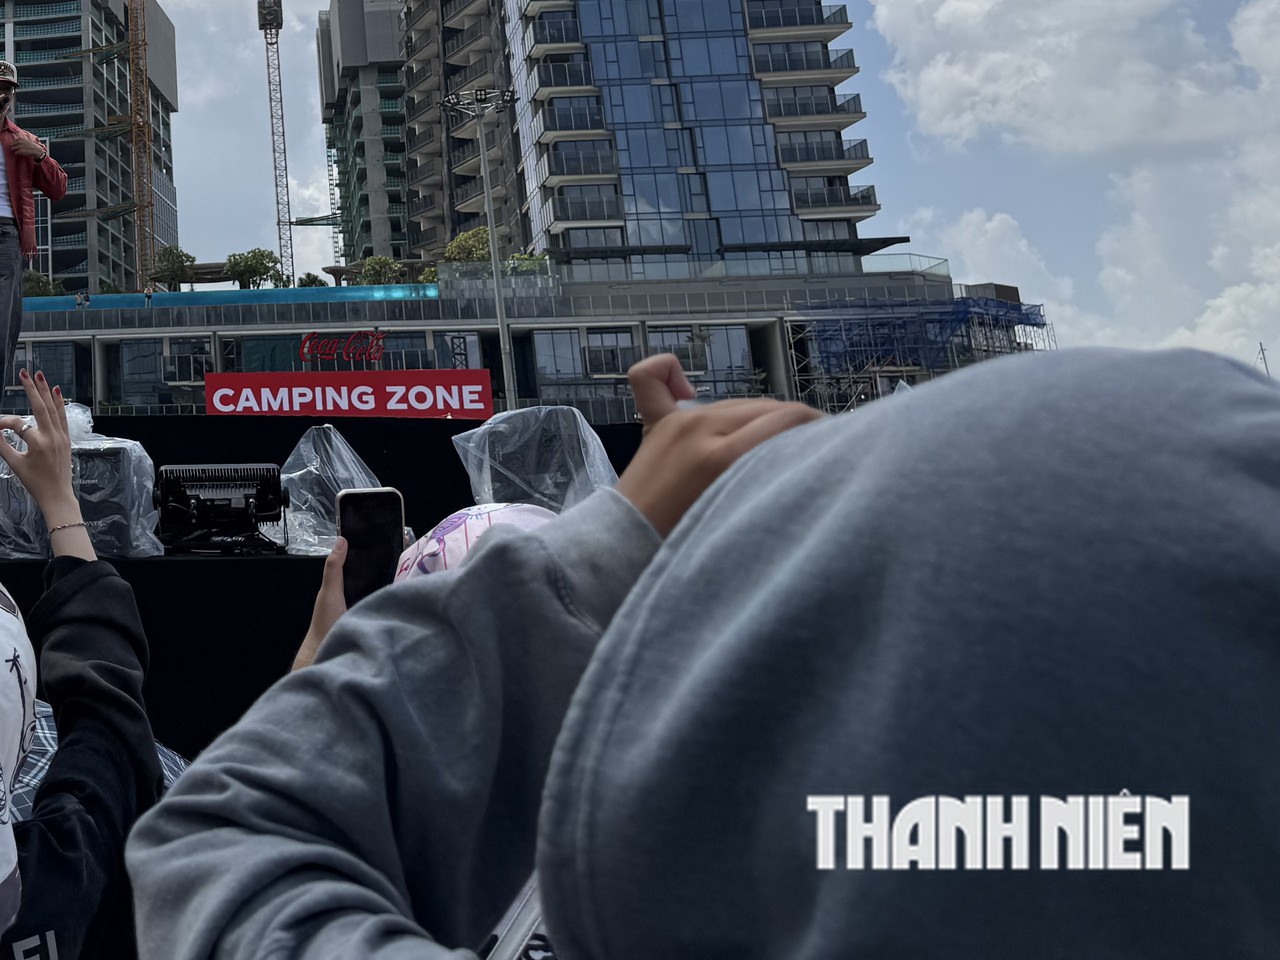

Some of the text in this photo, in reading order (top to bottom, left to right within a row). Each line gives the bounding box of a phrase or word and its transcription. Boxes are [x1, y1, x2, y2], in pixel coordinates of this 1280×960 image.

[299, 330, 390, 362] Coca-Cola
[212, 384, 485, 412] CAMPING ZONE
